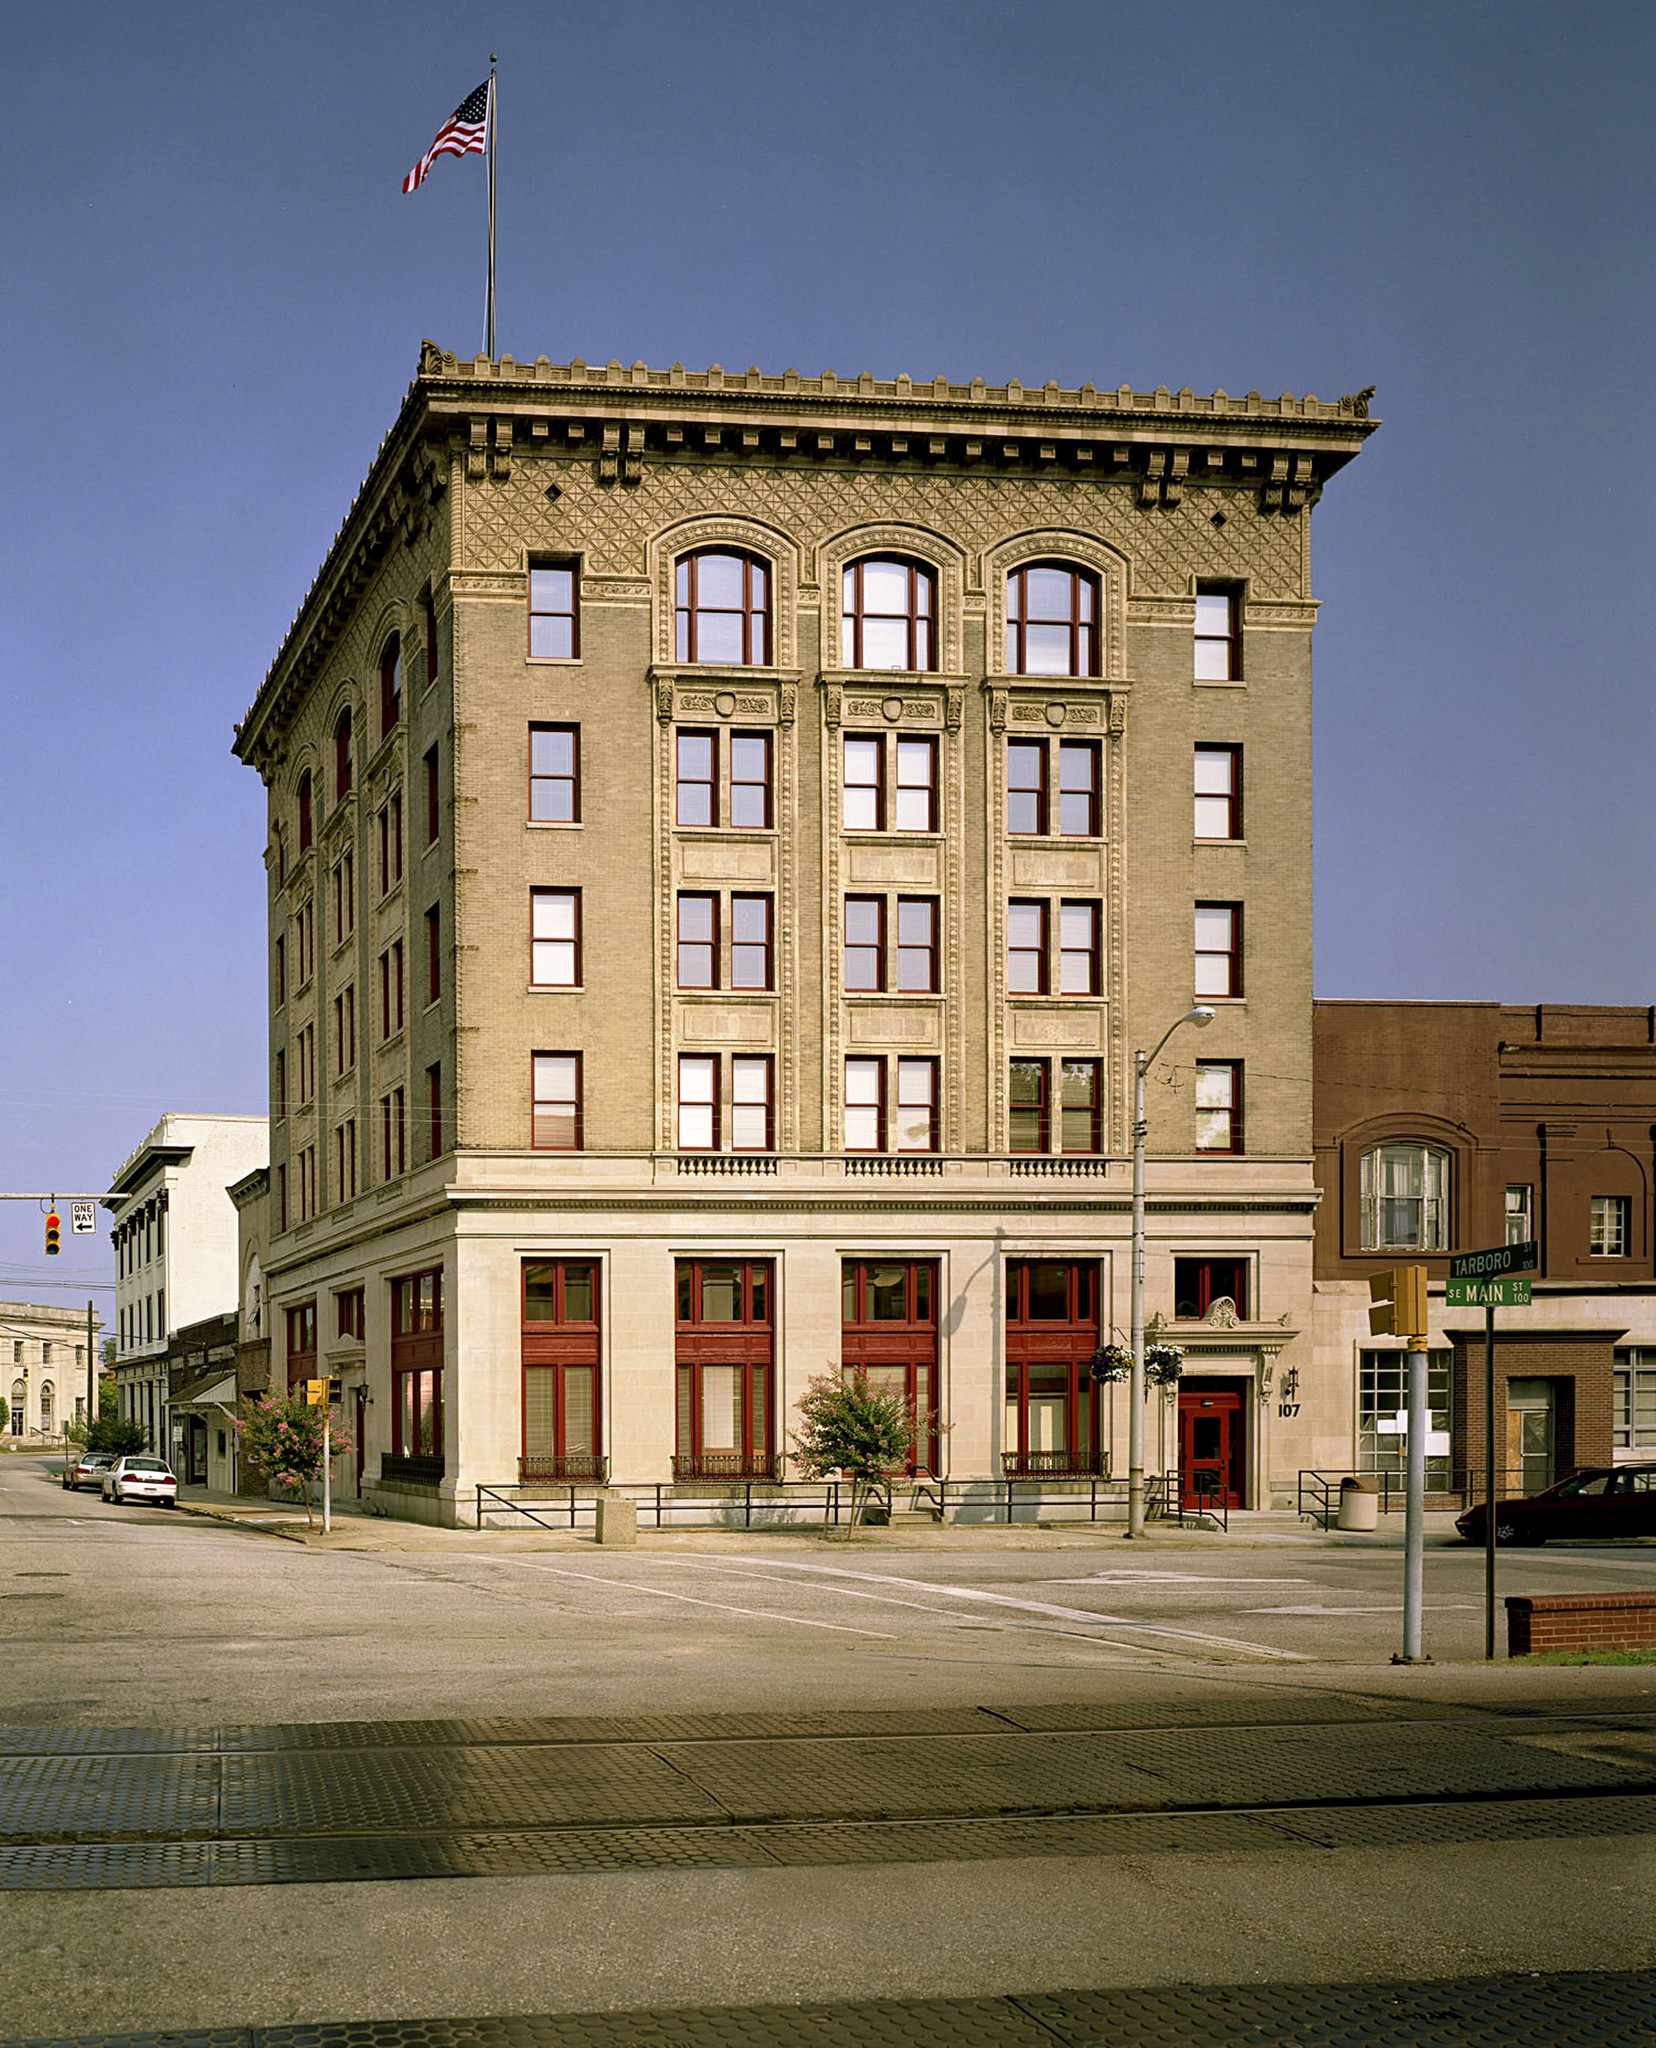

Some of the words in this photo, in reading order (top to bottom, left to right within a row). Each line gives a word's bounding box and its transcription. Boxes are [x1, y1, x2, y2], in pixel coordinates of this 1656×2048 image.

[74, 1204, 92, 1213] ONE
[74, 1213, 93, 1222] WAY
[1454, 1251, 1512, 1276] TARBORO
[1523, 1242, 1533, 1253] ST
[1522, 1259, 1534, 1270] 100
[1448, 1288, 1461, 1299] SE
[1466, 1284, 1503, 1302] MAIN
[1512, 1282, 1523, 1292] ST
[1513, 1293, 1529, 1303] 100
[1278, 1403, 1301, 1418] 107
